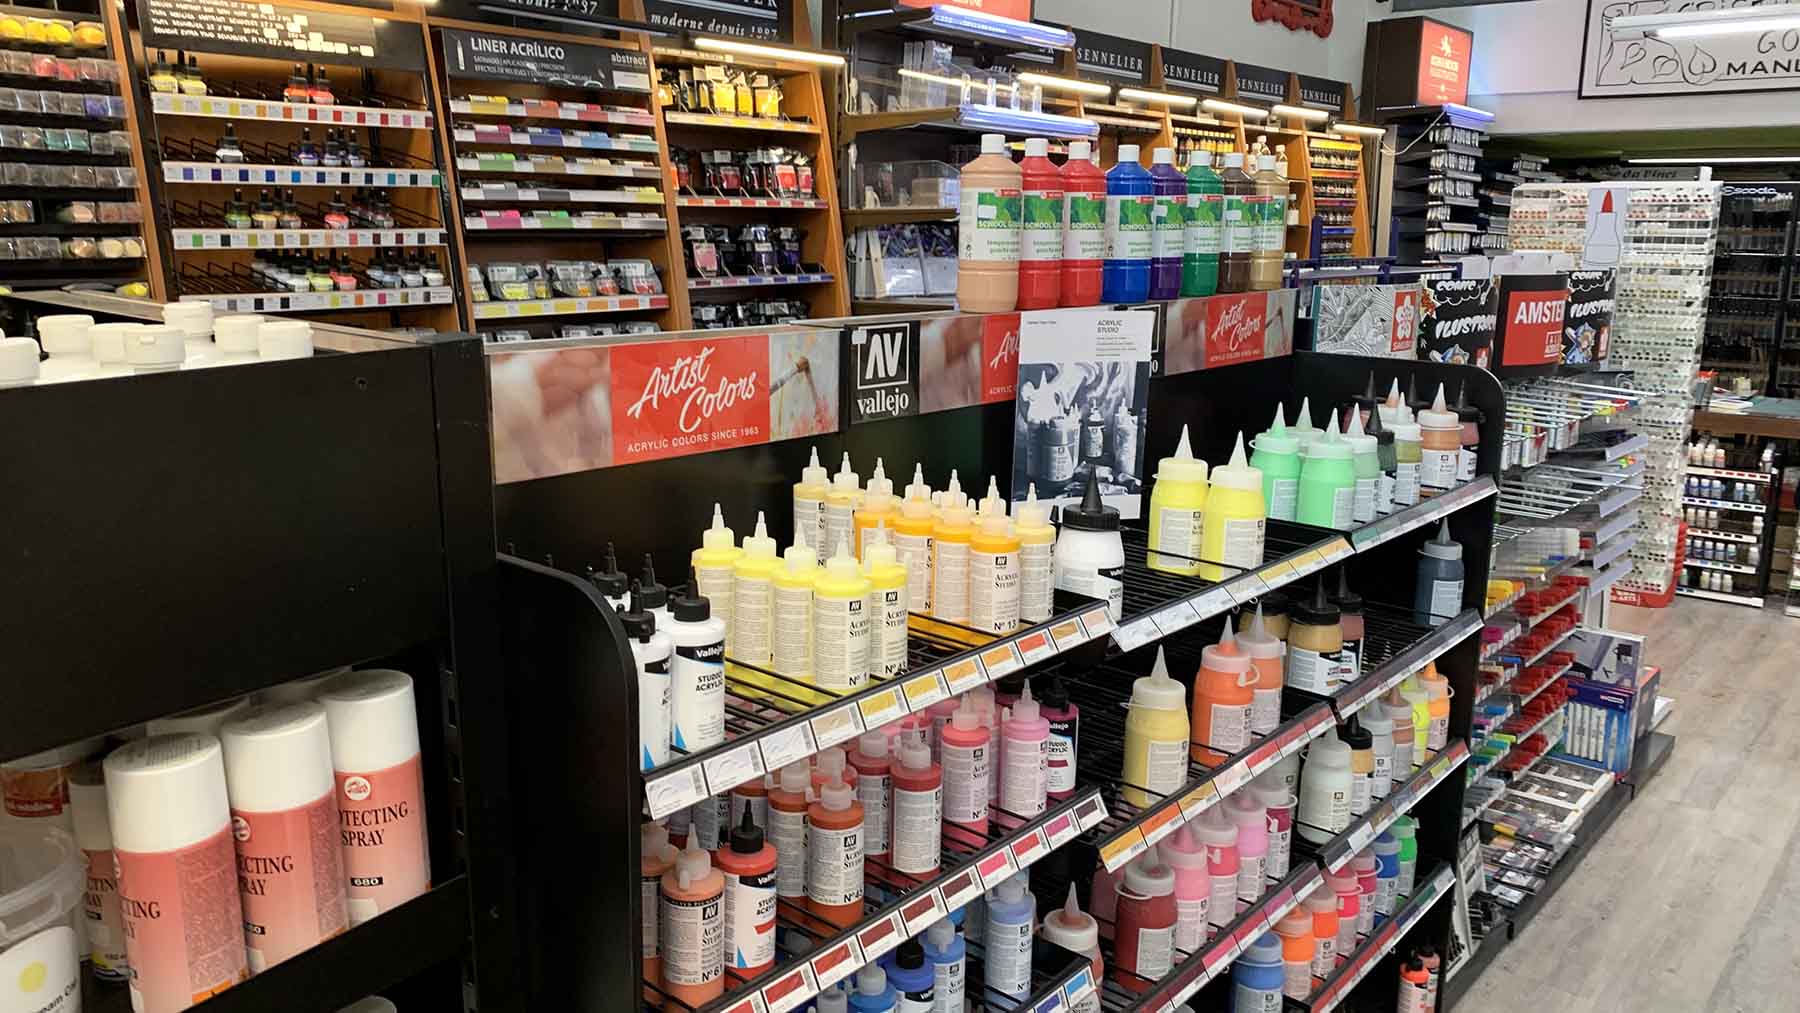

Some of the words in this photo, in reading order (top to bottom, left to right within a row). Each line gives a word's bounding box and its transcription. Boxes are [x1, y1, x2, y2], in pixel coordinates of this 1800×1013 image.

[650, 12, 703, 30] moderne
[708, 19, 745, 37] depuis
[470, 37, 508, 54] LINER
[510, 41, 565, 61] ACRÍLICO
[611, 53, 647, 66] abstract
[1076, 47, 1144, 72] SENNELIER
[1163, 63, 1220, 85] SENNELIER
[1237, 78, 1285, 96] SENNELIER
[1300, 88, 1341, 105] SENNELIER
[1211, 299, 1247, 342] Artist
[1230, 314, 1262, 352] Colors
[627, 346, 716, 418] Artist
[679, 370, 758, 433] Colors
[857, 389, 910, 418] vallejo
[627, 438, 669, 453] ACRYLIC
[671, 432, 709, 448] COLORS
[711, 429, 737, 441] SINCE
[342, 829, 384, 847] SPRAY
[354, 878, 379, 887] 680
